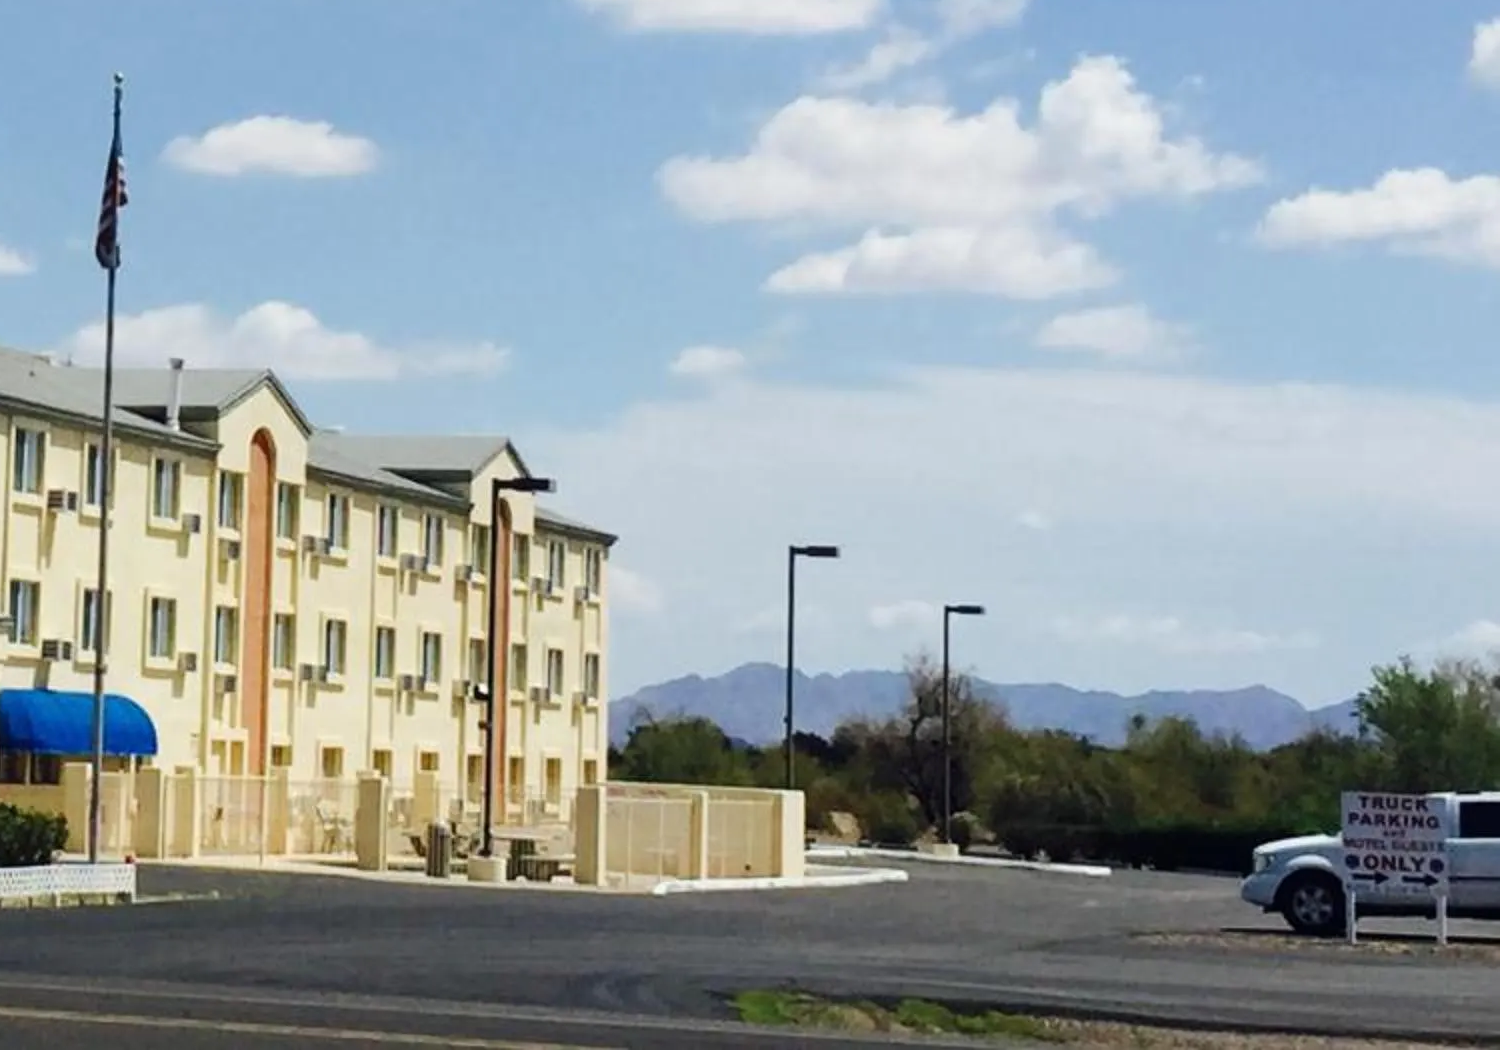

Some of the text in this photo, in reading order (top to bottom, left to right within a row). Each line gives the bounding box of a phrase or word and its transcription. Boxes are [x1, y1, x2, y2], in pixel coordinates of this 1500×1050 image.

[1358, 795, 1428, 812] TRUCK
[1348, 811, 1440, 829] PARKING
[1363, 854, 1425, 872] ONLY
